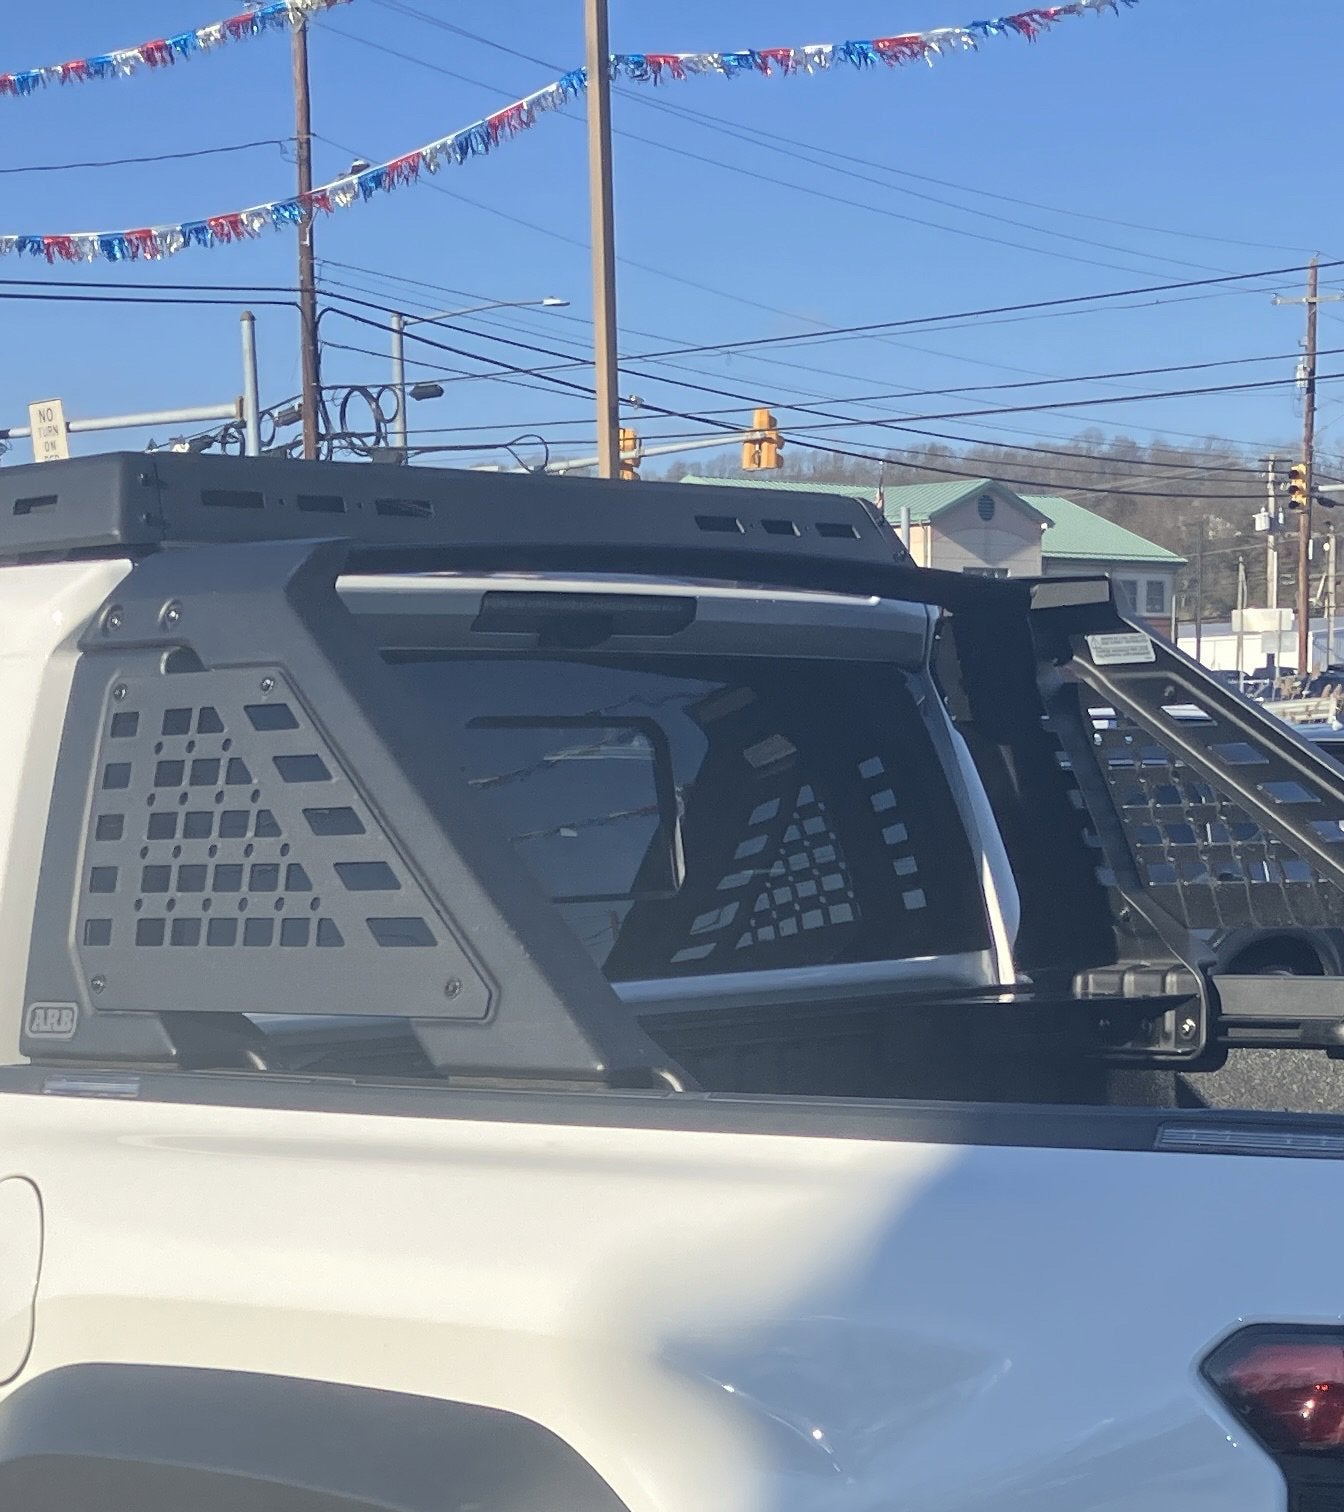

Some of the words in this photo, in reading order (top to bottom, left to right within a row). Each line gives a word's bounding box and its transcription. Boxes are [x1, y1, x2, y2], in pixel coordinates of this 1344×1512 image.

[39, 408, 53, 423] NO
[38, 424, 59, 438] TURN
[44, 440, 57, 452] ON
[31, 1007, 75, 1033] ARB
